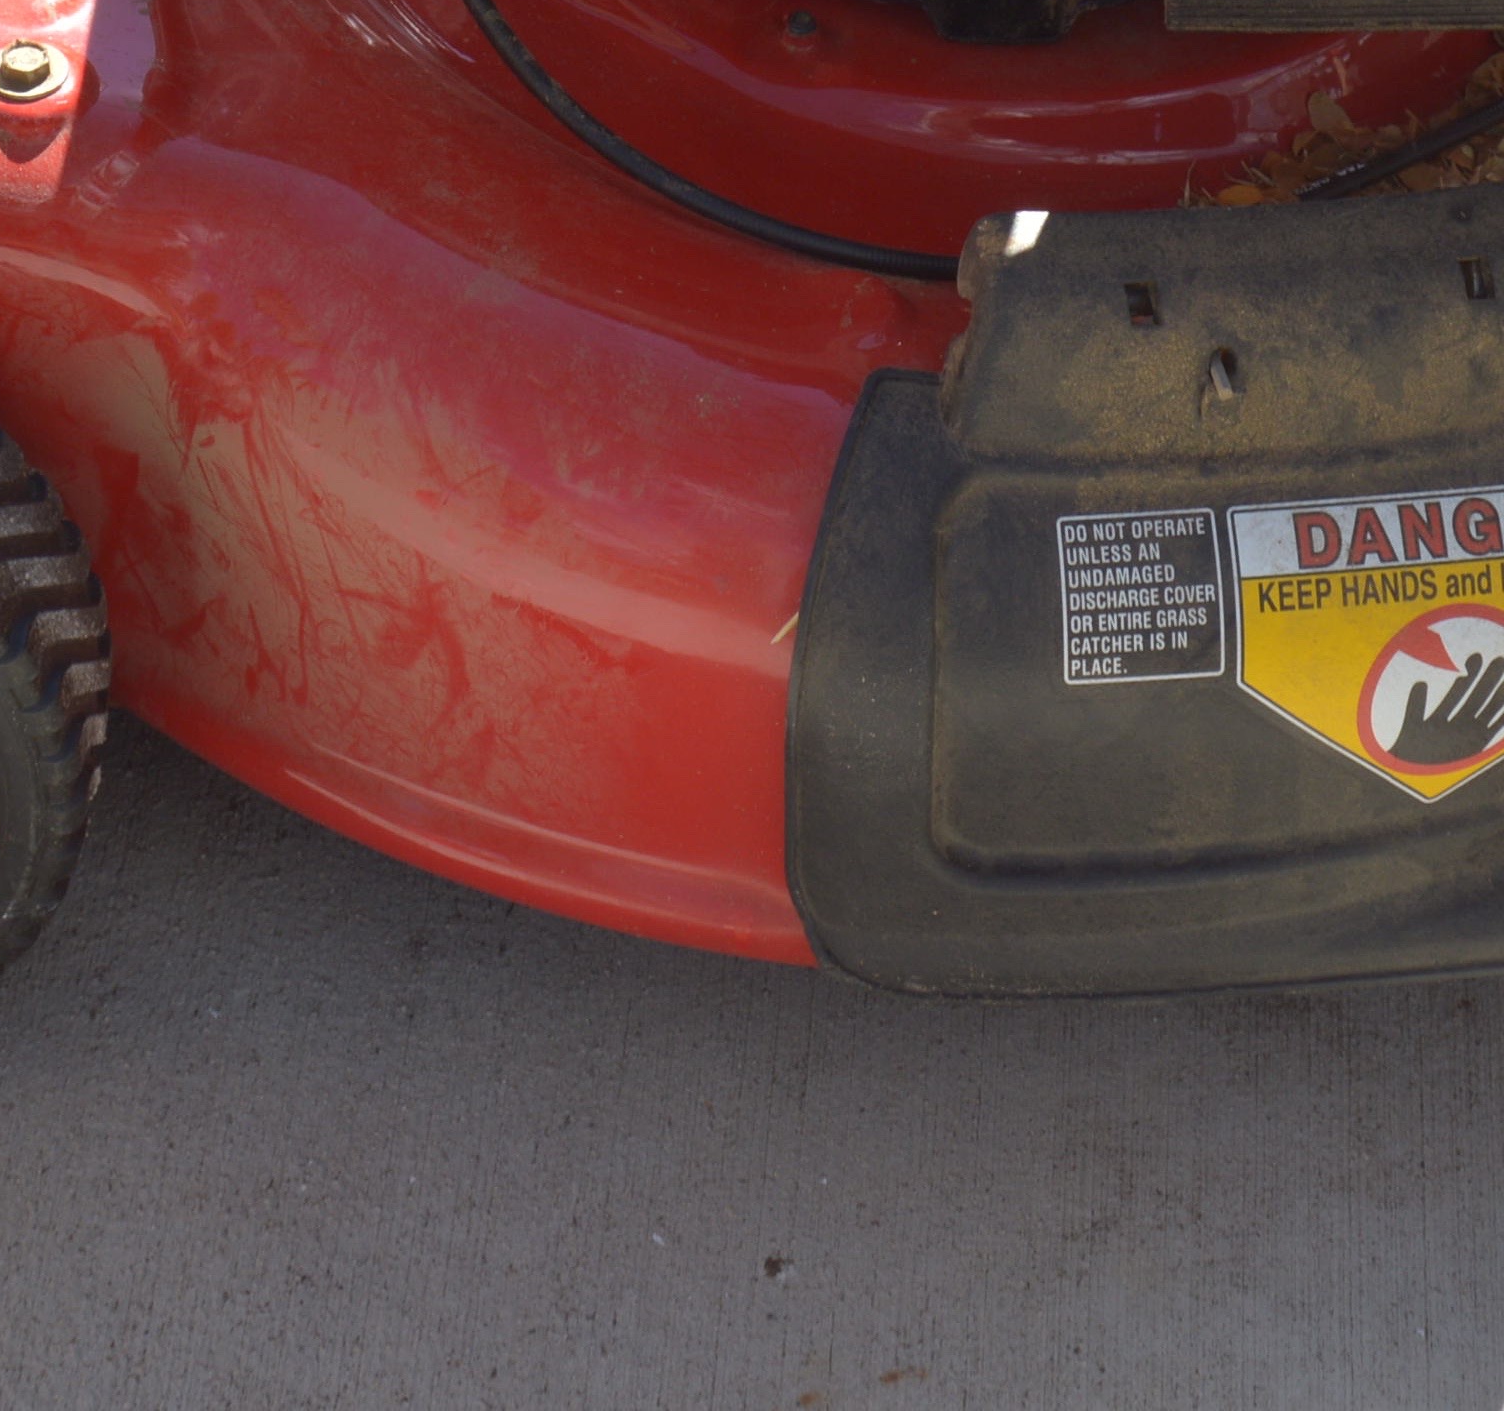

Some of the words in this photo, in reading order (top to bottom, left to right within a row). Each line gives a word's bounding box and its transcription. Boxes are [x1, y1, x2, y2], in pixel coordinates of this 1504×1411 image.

[1064, 524, 1089, 544] DO
[1093, 522, 1126, 541] NOT
[1131, 517, 1206, 540] OPERATE
[1067, 543, 1132, 564] UNLESS
[1137, 541, 1161, 562] AN
[1068, 563, 1175, 587] UNDAMAGED
[1070, 586, 1160, 611] DISCHARGE
[1164, 583, 1216, 606] COVER
[1258, 580, 1333, 614] KEEP
[1341, 570, 1438, 609] HANDS
[1445, 567, 1493, 599] and
[1070, 612, 1094, 633] OR
[1098, 610, 1152, 632] ENTIRE
[1155, 606, 1208, 629] GRASS
[1071, 632, 1144, 656] CATCHER
[1149, 631, 1165, 651] IS
[1171, 629, 1188, 649] IN
[1071, 655, 1128, 677] PLACE.
